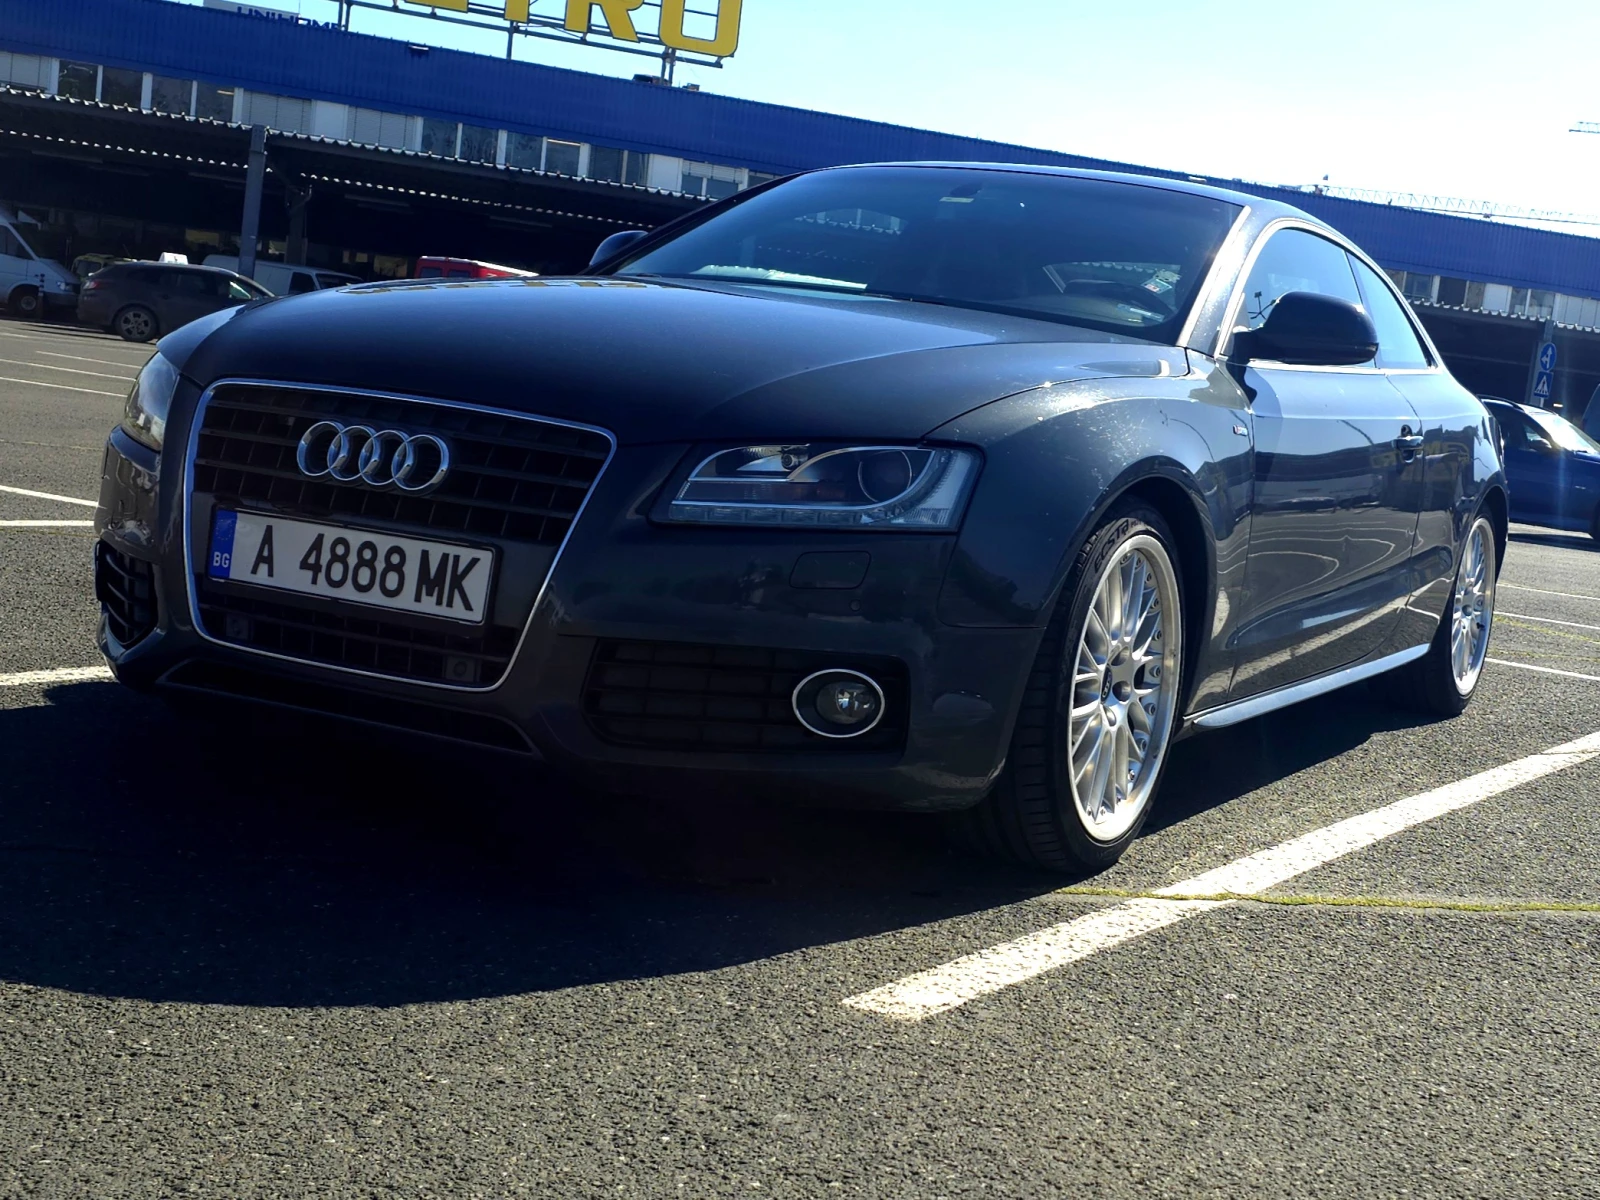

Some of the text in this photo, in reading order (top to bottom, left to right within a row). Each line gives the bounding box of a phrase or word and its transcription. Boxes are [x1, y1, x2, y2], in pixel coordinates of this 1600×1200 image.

[404, 0, 743, 58] RO
[213, 551, 231, 568] BG
[250, 524, 481, 612] A 4888 MK
